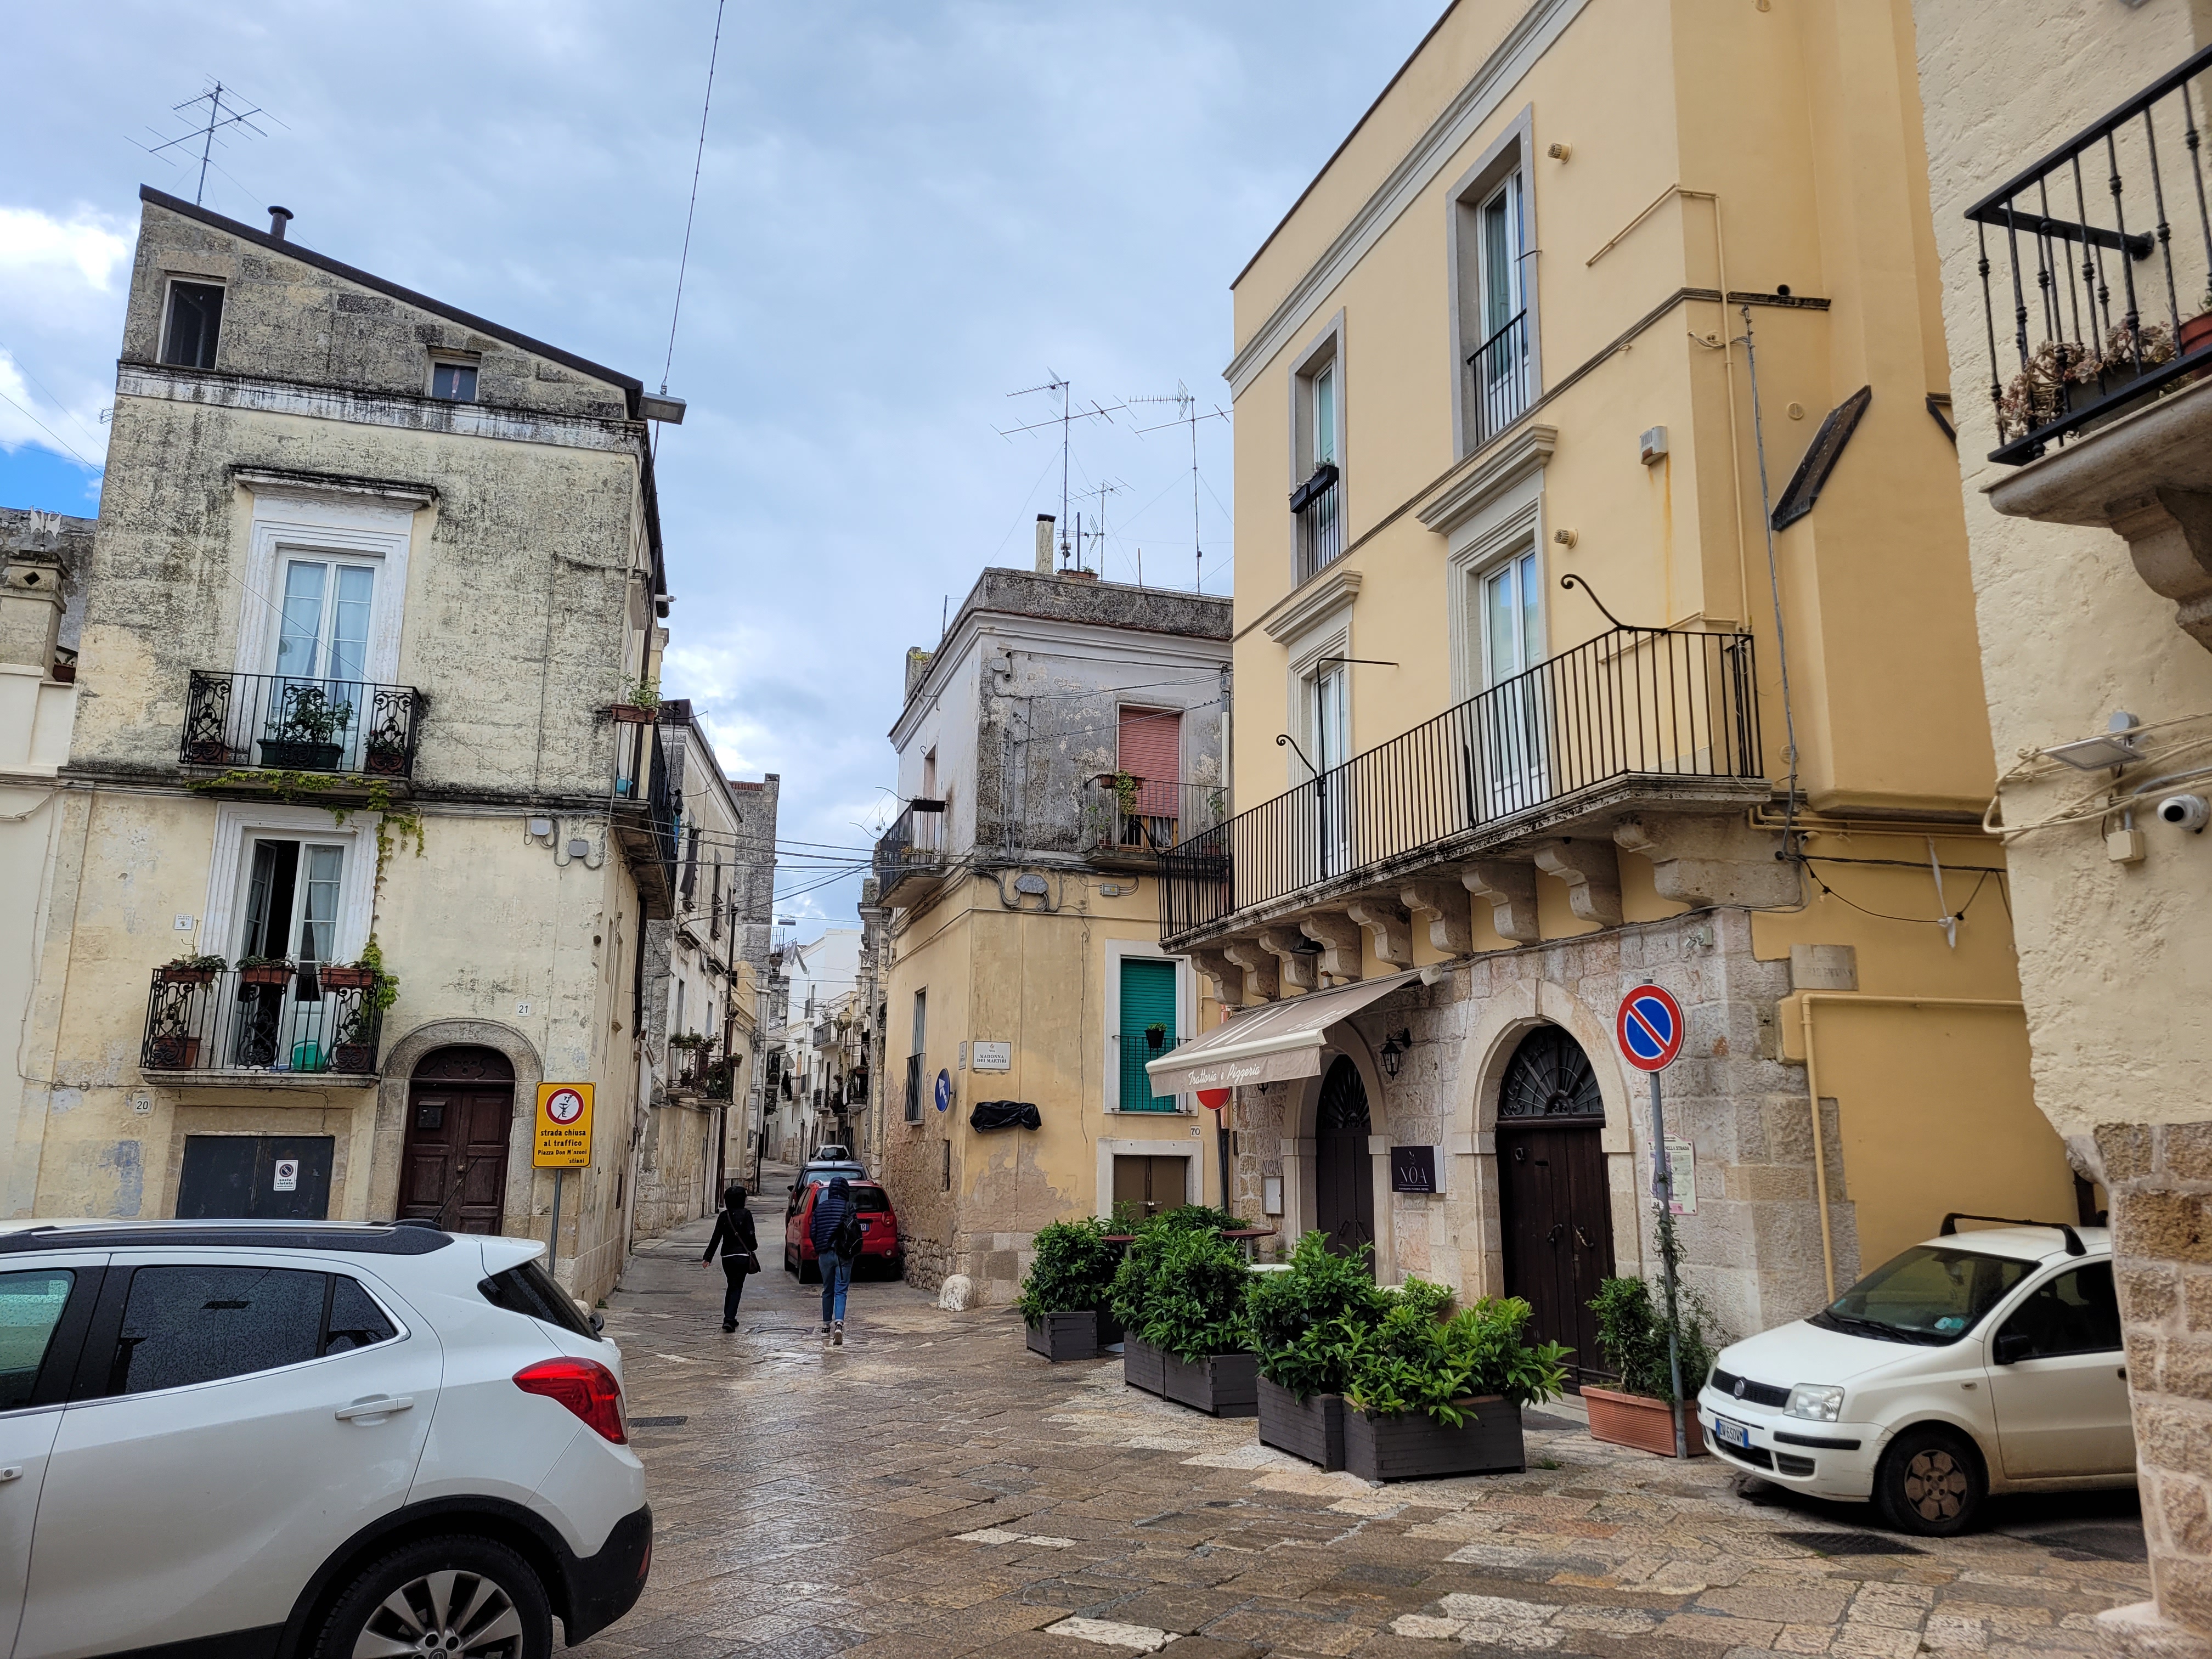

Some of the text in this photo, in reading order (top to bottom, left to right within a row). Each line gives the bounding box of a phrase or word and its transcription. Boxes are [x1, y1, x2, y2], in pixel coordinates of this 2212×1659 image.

[518, 1005, 528, 1013] 21
[1188, 1063, 1260, 1085] Trattoria e Pizzeria
[136, 1101, 149, 1110] 20
[1190, 1127, 1200, 1136] 70
[1262, 1159, 1280, 1174] NOA
[1400, 1166, 1427, 1184] NOA
